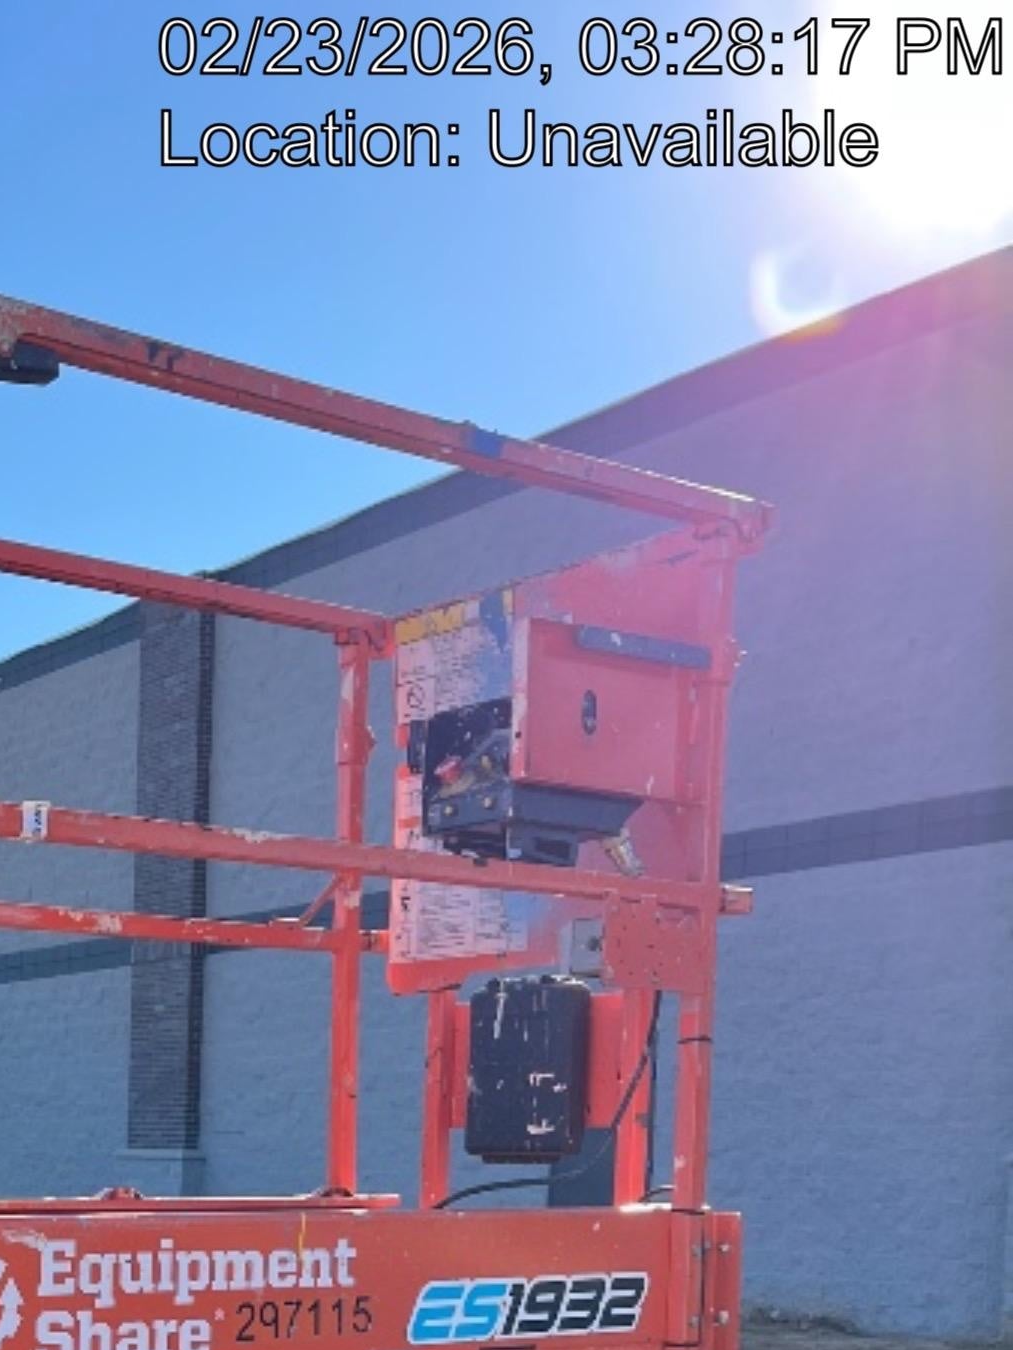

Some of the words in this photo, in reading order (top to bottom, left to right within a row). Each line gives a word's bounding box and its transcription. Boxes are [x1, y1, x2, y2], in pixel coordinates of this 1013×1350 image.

[35, 1238, 357, 1310] Equipment
[406, 1272, 648, 1345] ES1932
[236, 1295, 374, 1343] 297115
